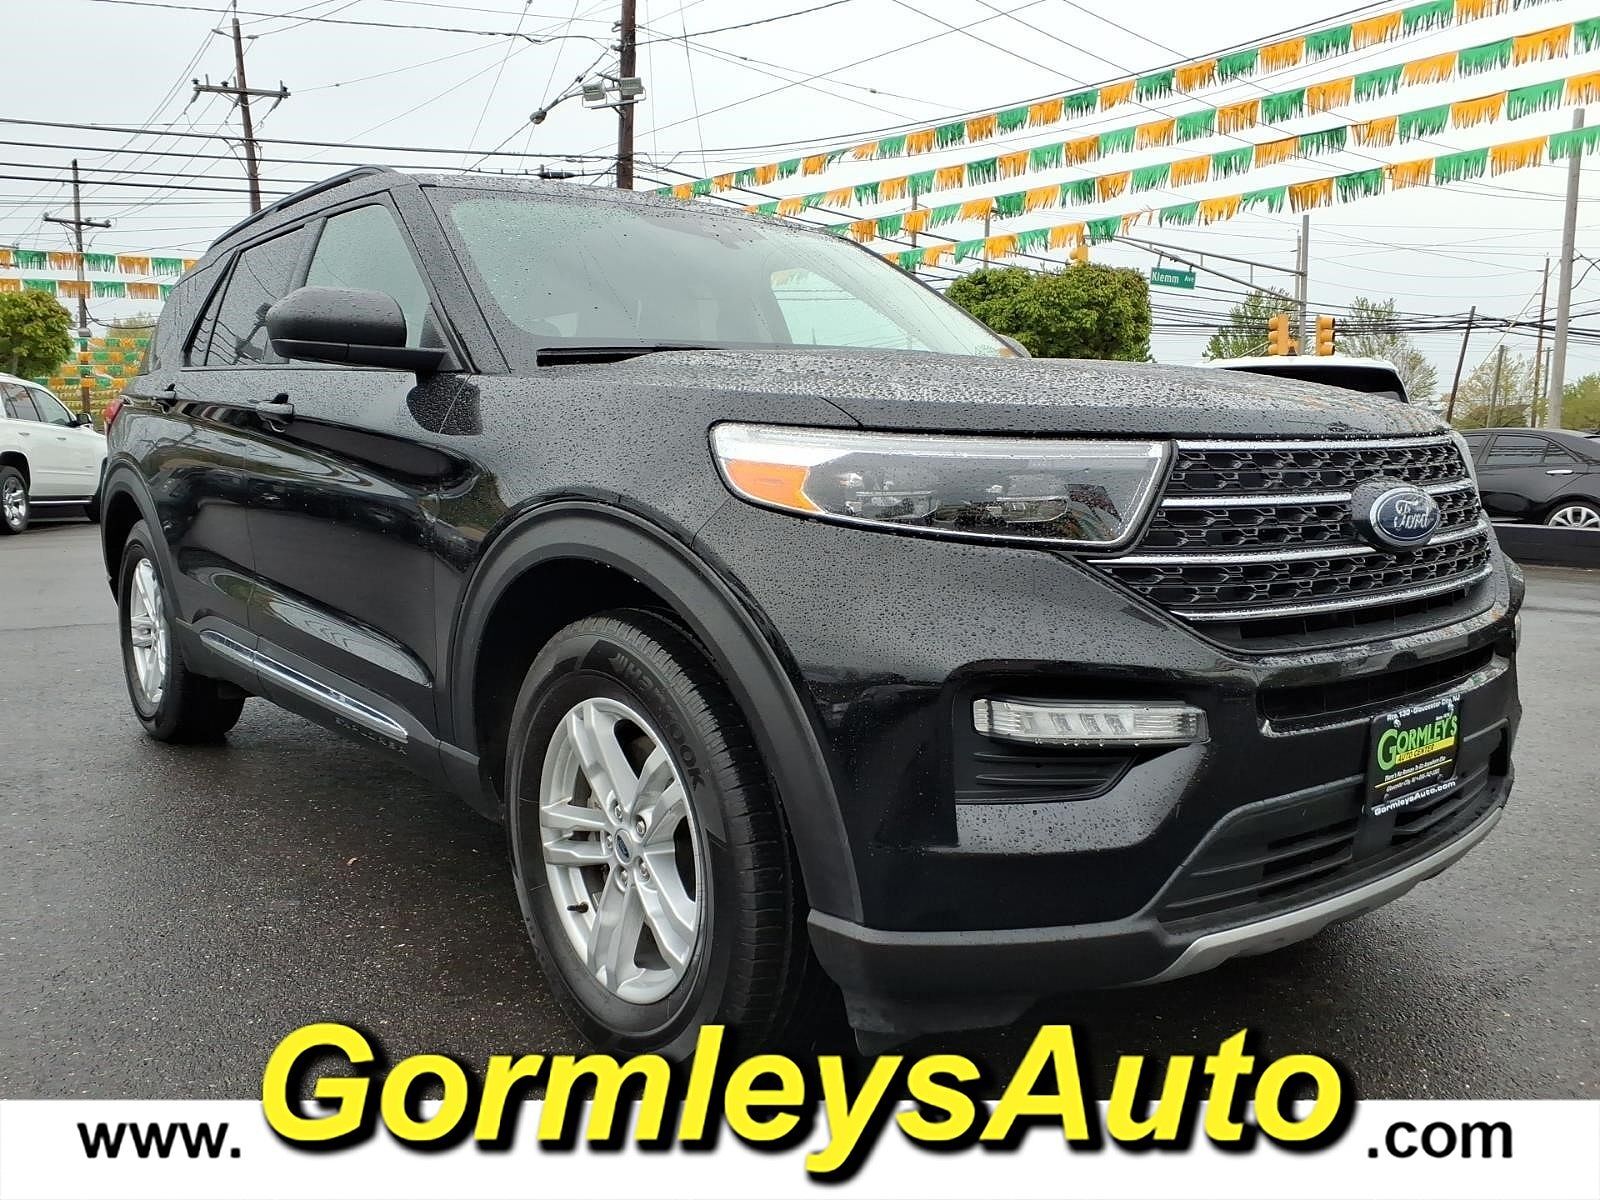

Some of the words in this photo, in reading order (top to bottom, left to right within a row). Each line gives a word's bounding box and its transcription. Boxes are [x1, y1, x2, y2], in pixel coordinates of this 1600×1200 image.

[1152, 271, 1179, 284] Klemm
[1184, 275, 1195, 283] Ave
[1394, 499, 1429, 530] Ford
[1377, 714, 1458, 771] GORMLEY'S
[1374, 781, 1456, 816] GormleysAuto.com
